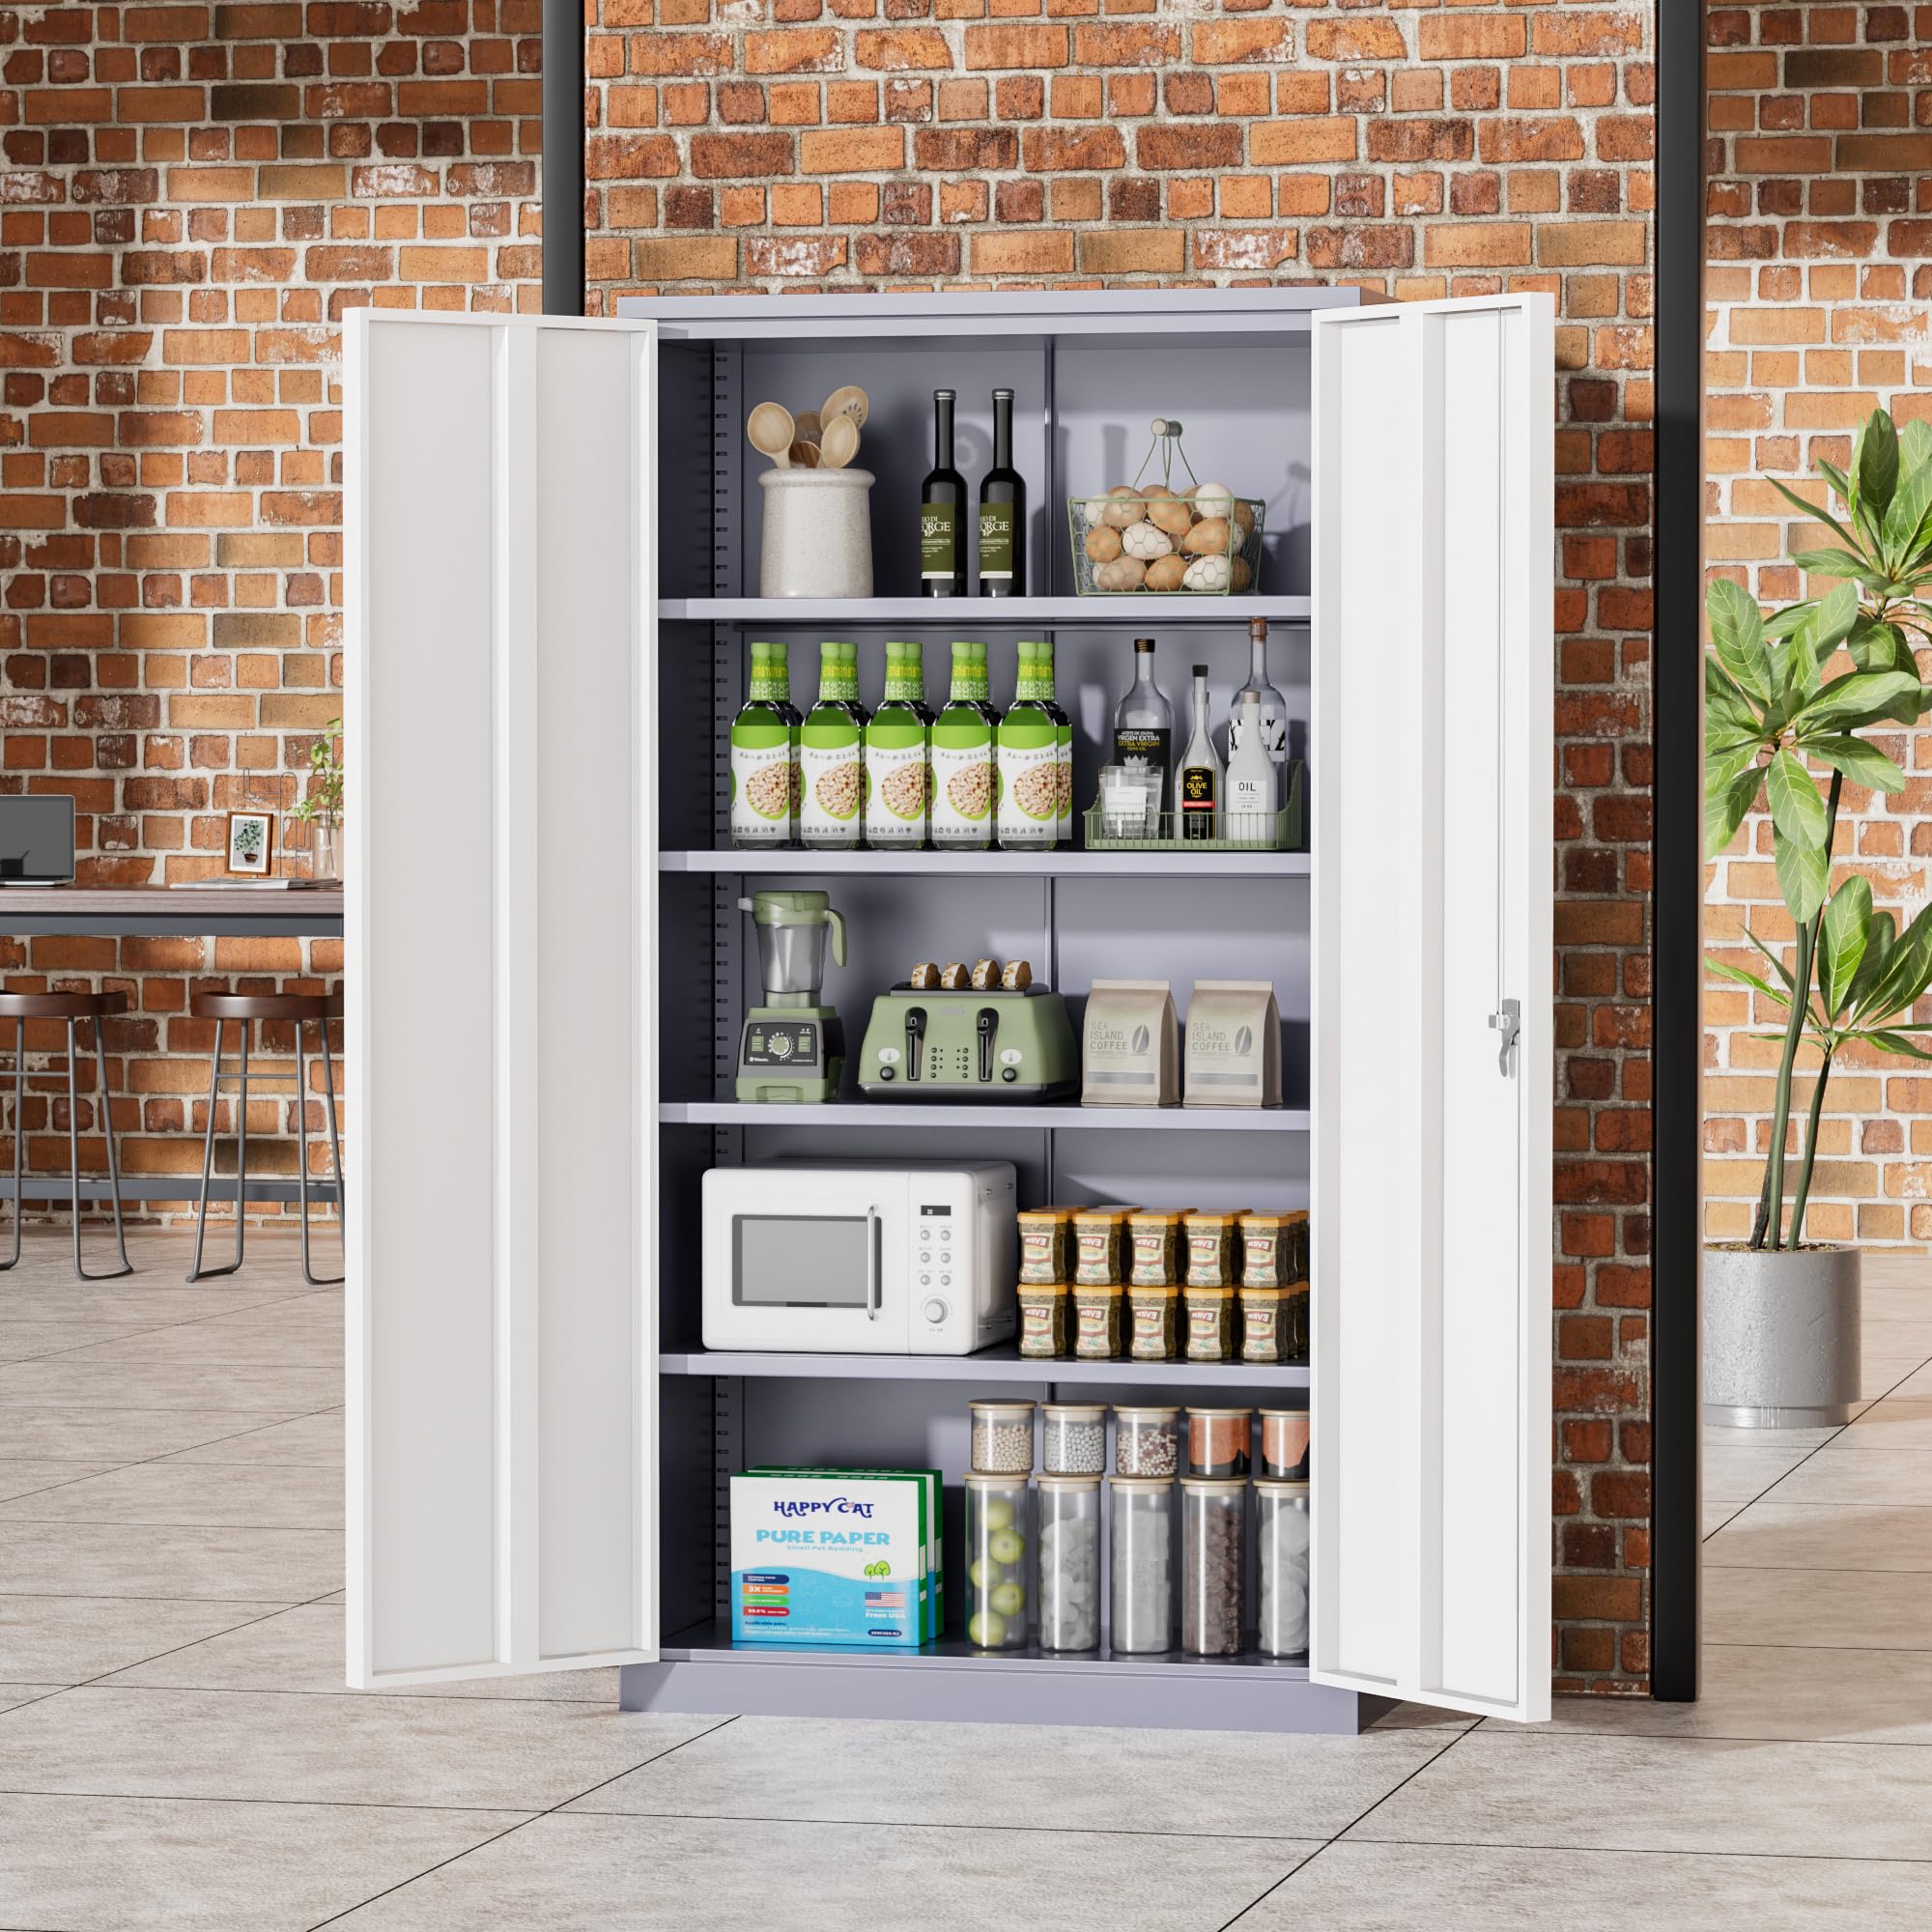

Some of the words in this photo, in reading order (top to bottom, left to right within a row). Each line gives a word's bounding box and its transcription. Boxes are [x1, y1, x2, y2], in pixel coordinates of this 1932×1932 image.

[1239, 782, 1257, 792] OIL
[1091, 1022, 1108, 1030] SEA
[1193, 1022, 1211, 1031] SEA
[1090, 1031, 1123, 1040] ISLAND
[1192, 1032, 1227, 1041] ISLAND
[1090, 1041, 1128, 1050] COFFEE
[1192, 1042, 1230, 1051] COFFEE
[774, 1497, 843, 1517] HAPPY
[838, 1501, 874, 1518] CAT
[756, 1529, 815, 1544] PURE
[820, 1531, 890, 1546] PAPER
